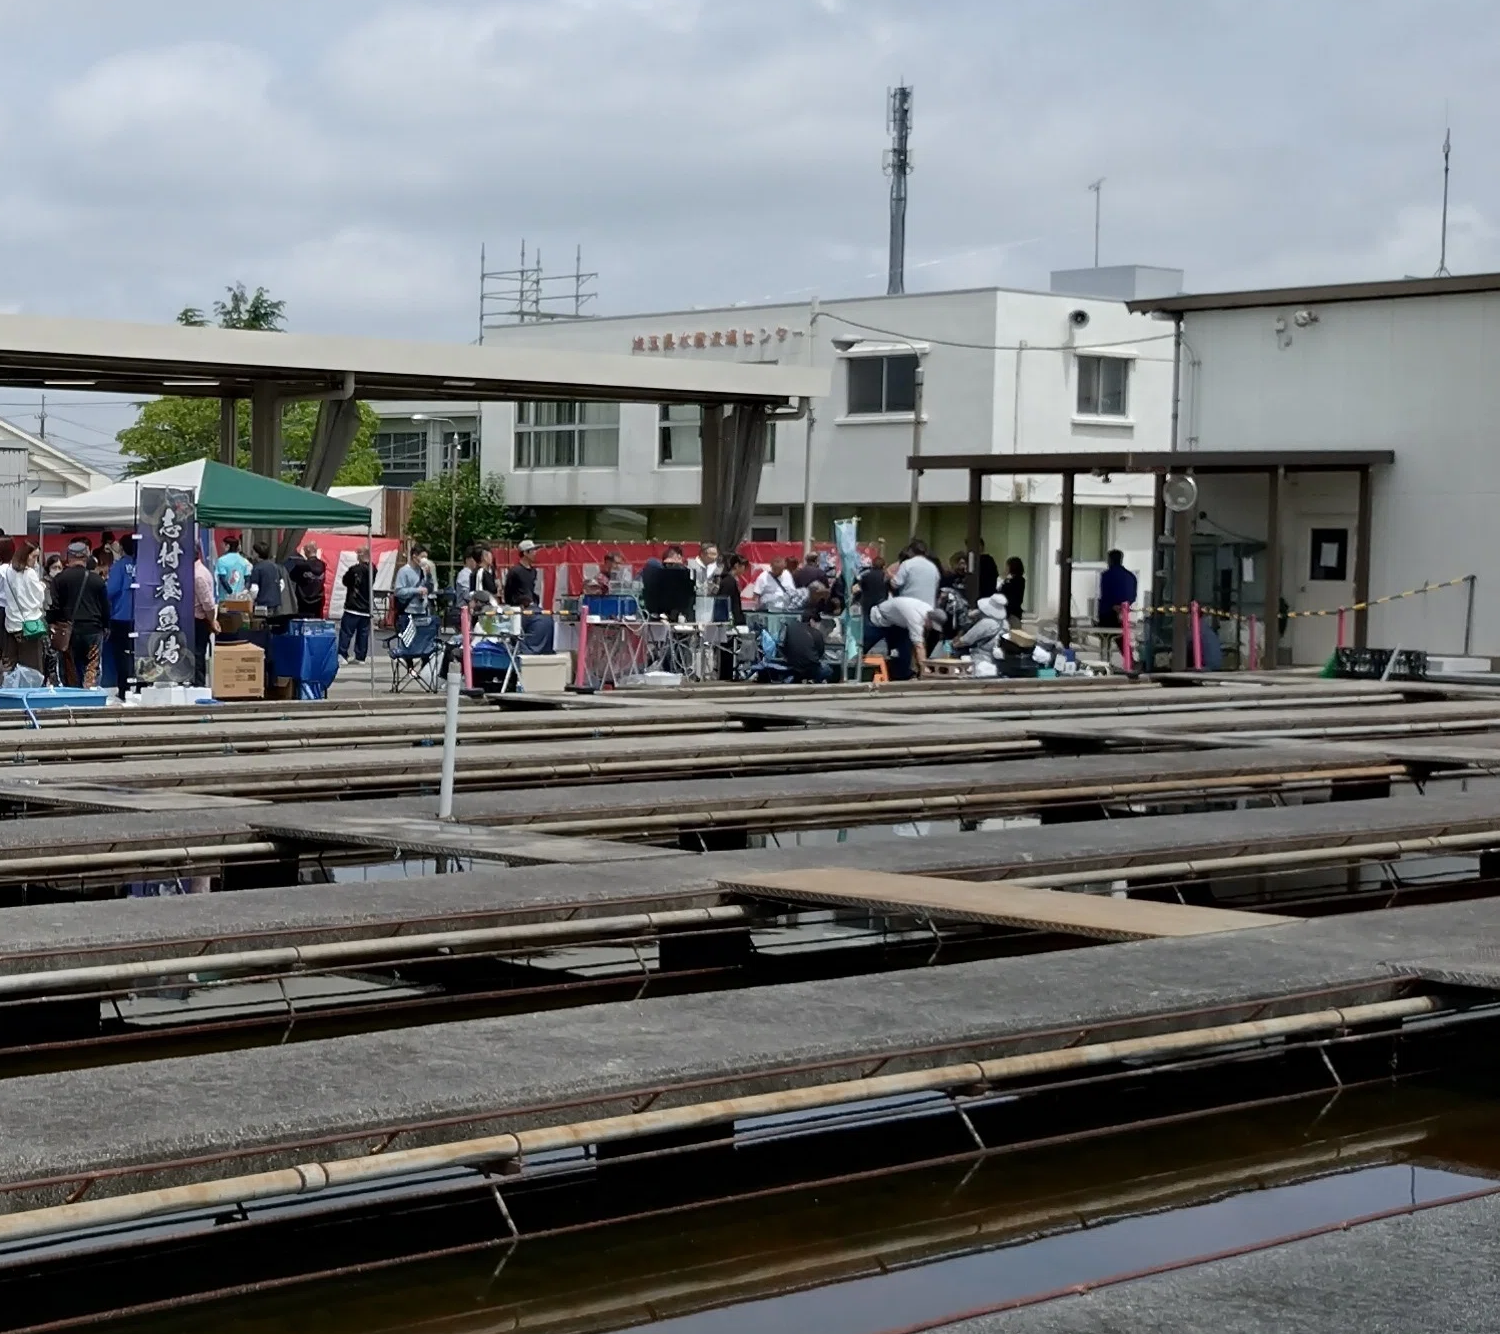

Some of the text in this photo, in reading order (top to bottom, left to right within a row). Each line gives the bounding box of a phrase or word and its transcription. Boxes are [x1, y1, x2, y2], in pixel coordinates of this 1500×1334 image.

[155, 507, 183, 665] 志村養魚場
